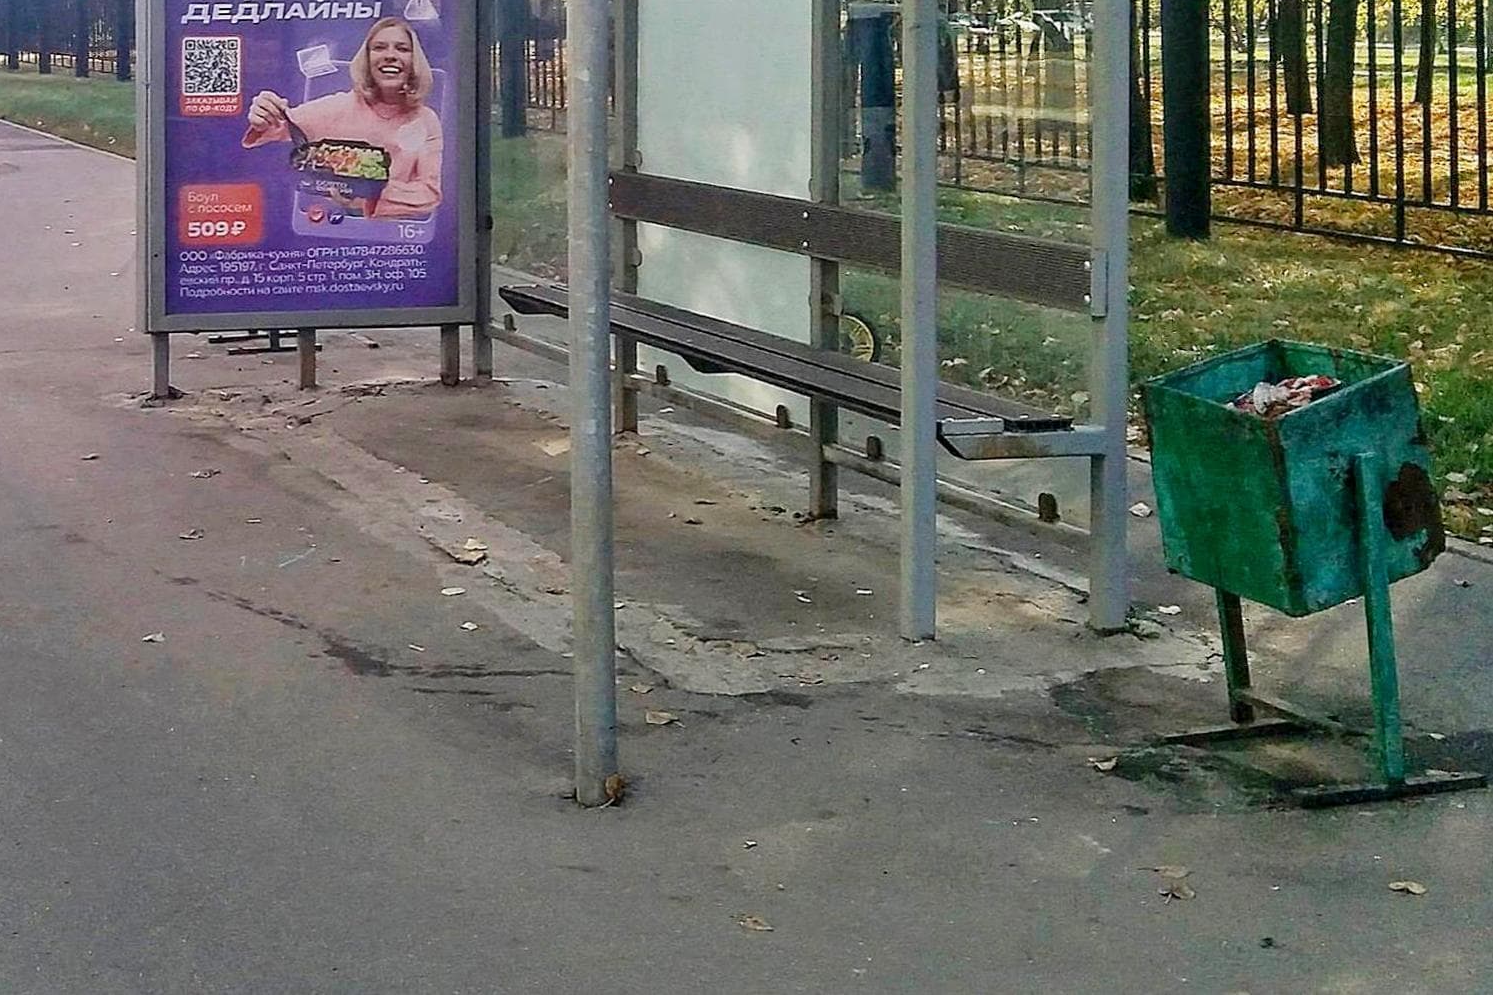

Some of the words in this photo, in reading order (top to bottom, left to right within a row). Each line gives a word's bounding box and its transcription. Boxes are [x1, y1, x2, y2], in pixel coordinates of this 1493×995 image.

[188, 191, 219, 205] Боул
[197, 204, 253, 214] лососем
[398, 224, 425, 238] 16+
[179, 250, 208, 262] ООО
[307, 247, 339, 258] ОГРН
[298, 271, 306, 282] 5
[179, 286, 256, 299] Подробности
[256, 286, 271, 295] на
[272, 285, 304, 295] сайте
